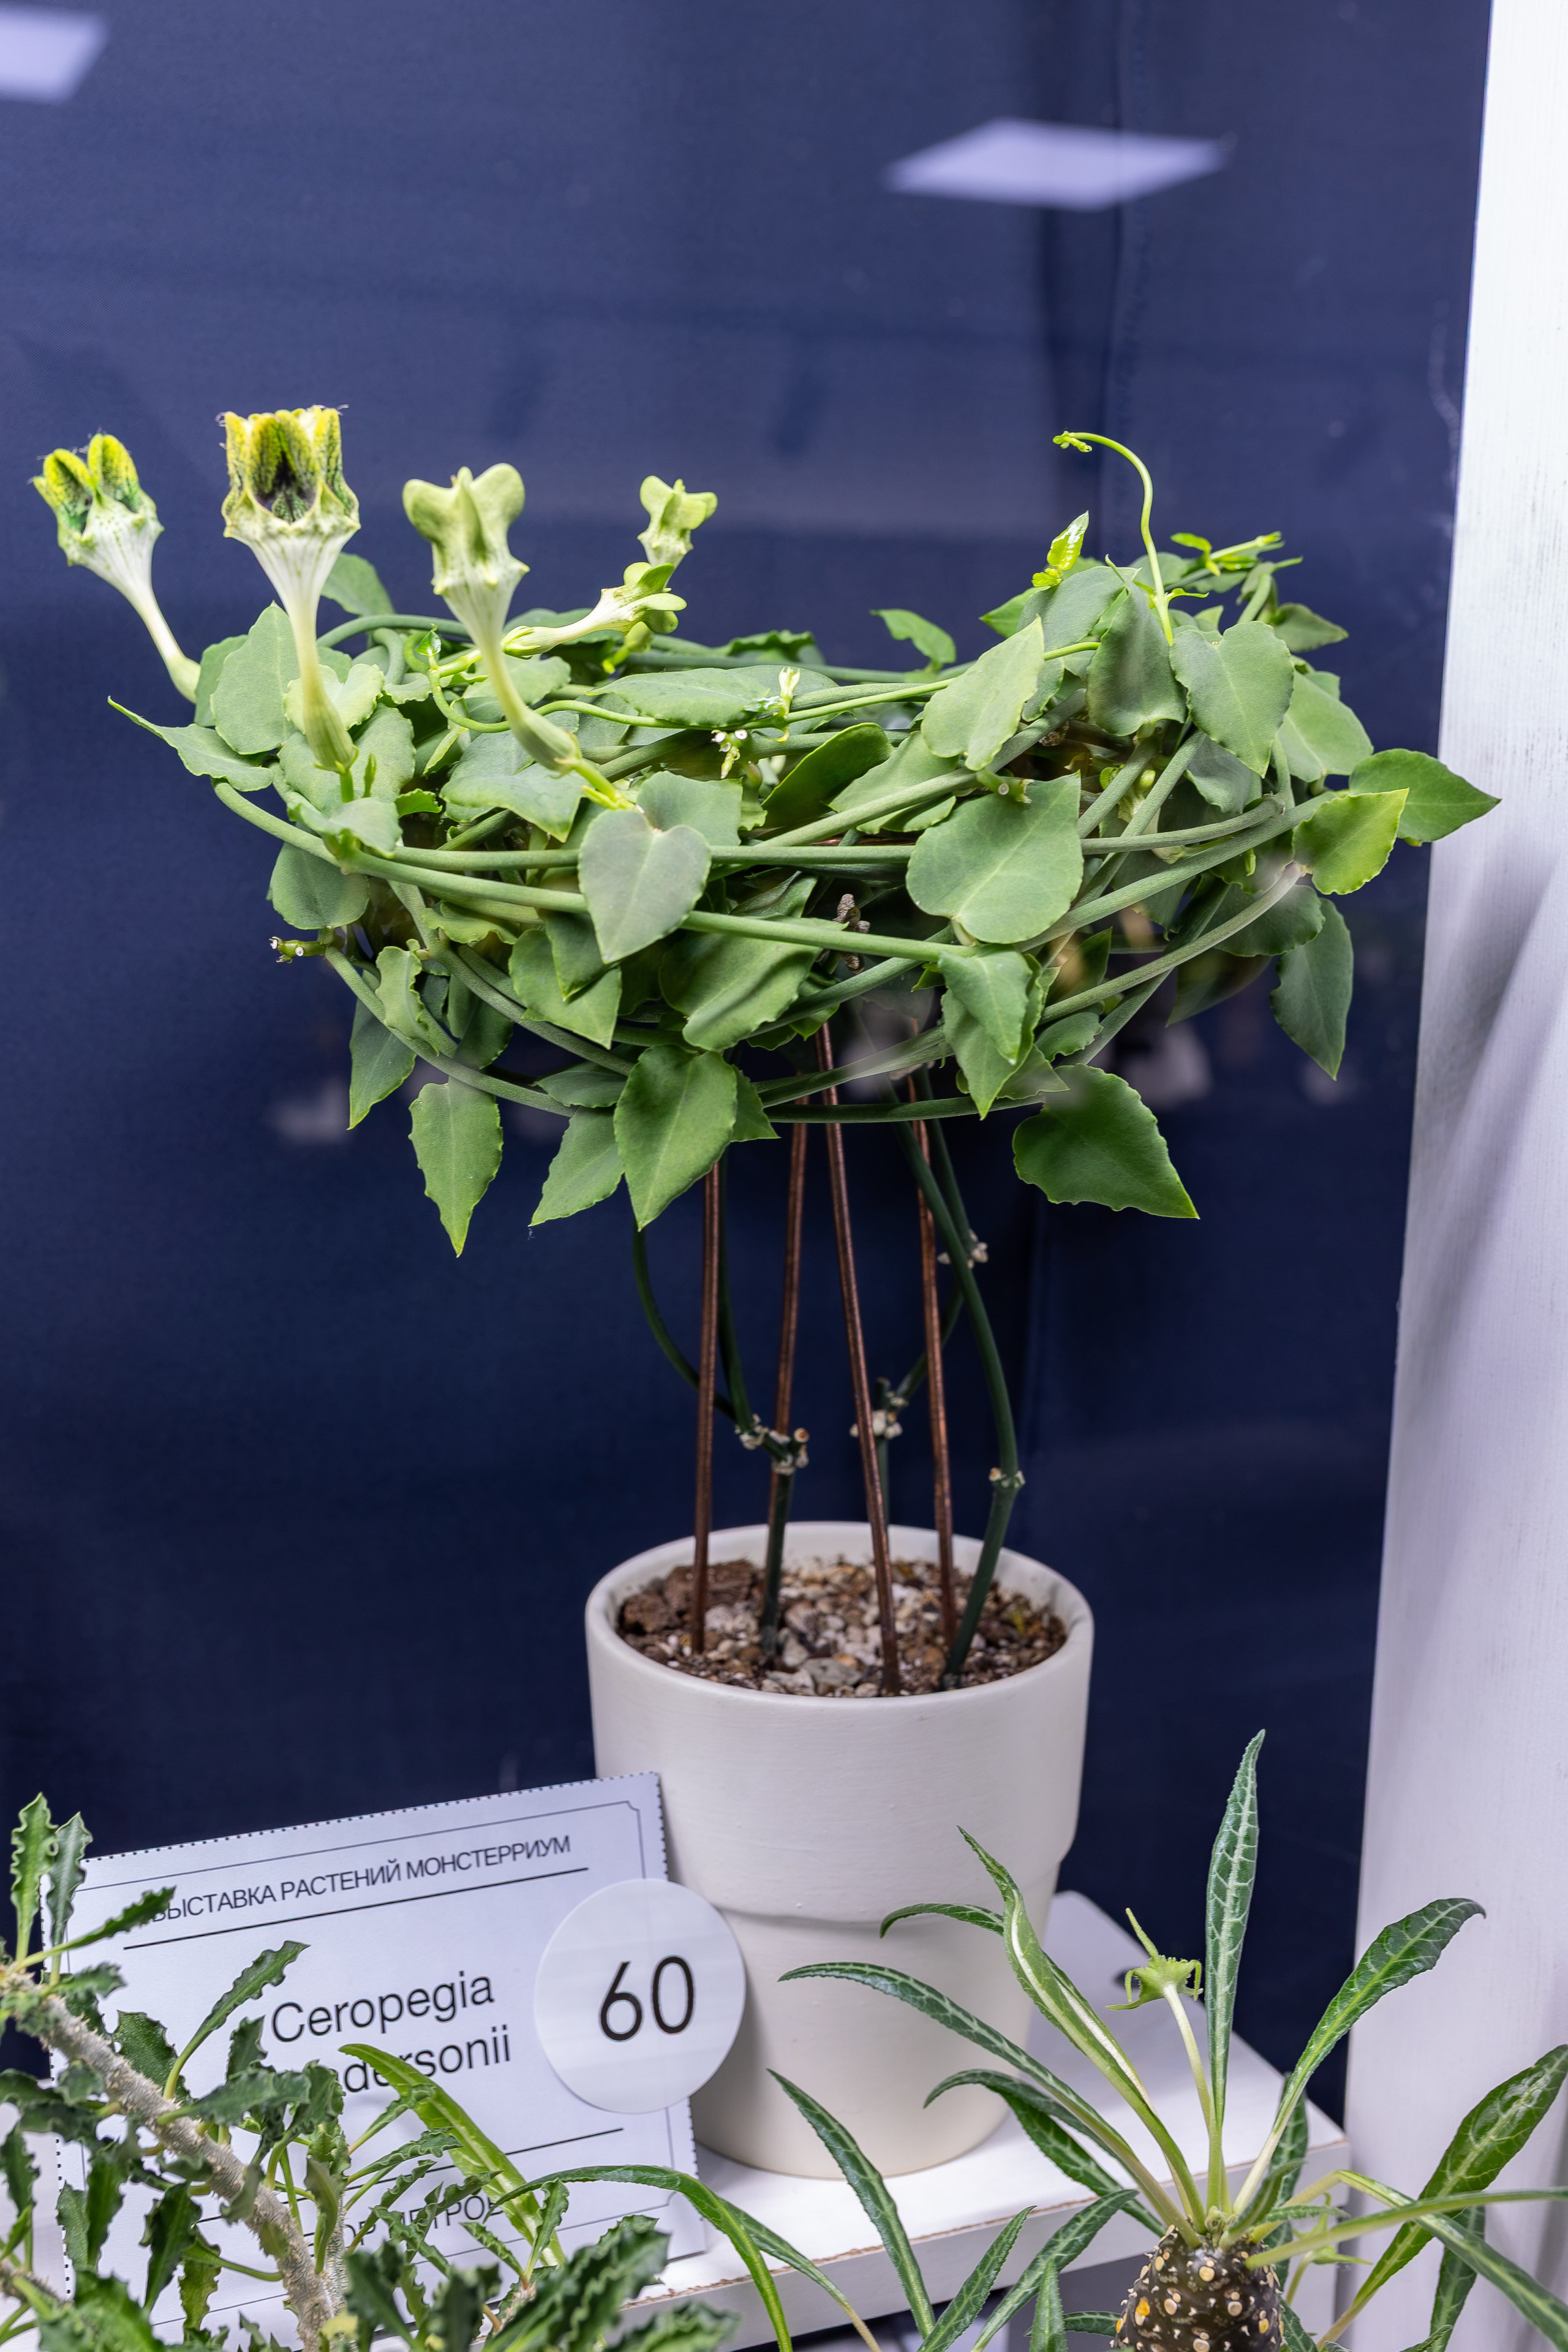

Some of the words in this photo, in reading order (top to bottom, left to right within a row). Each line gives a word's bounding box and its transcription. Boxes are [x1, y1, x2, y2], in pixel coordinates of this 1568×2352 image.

[281, 1858, 401, 1901] РАСТЕНИЙ
[406, 1834, 571, 1879] МОНСТЕРРИУМ
[271, 1970, 494, 2043] Ceropegia
[599, 1956, 694, 2041] 60
